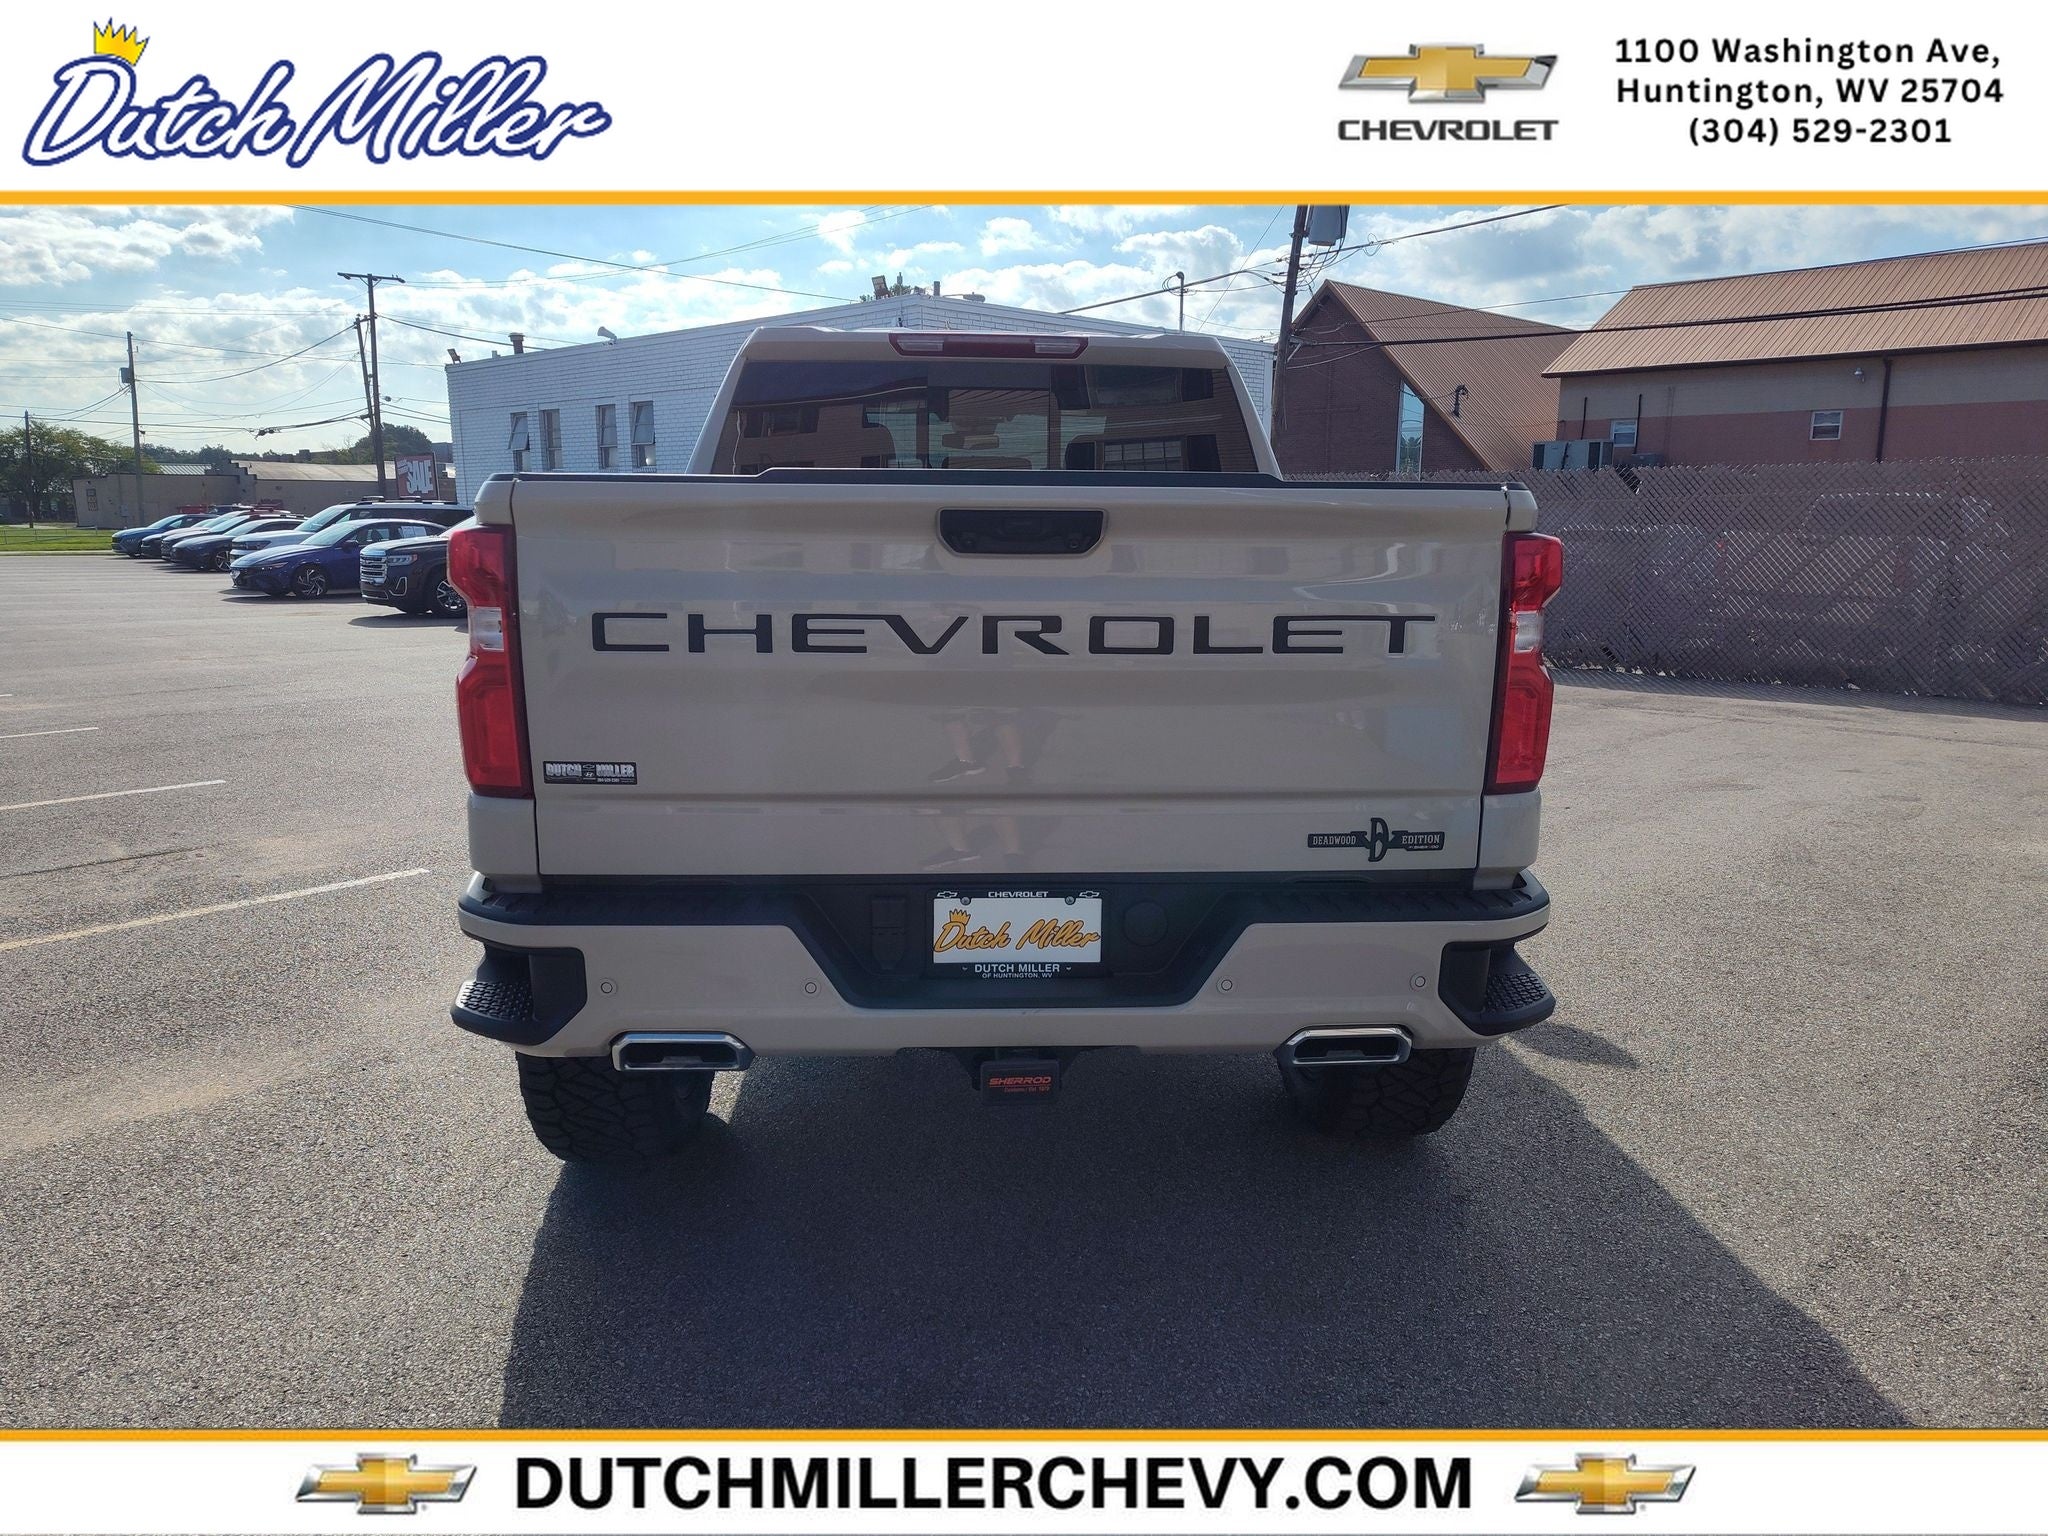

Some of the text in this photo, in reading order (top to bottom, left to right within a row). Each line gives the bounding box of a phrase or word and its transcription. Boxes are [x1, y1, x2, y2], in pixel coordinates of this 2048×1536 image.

[406, 460, 433, 494] SALE
[591, 612, 1436, 656] CHEVROLET
[545, 763, 582, 776] DUTCH
[1312, 834, 1440, 845] DEADWOOD EDITION
[933, 918, 1101, 952] Dutch Miller
[974, 964, 1060, 973] DUTCH MILLER
[989, 1076, 1052, 1086] SHERROD
